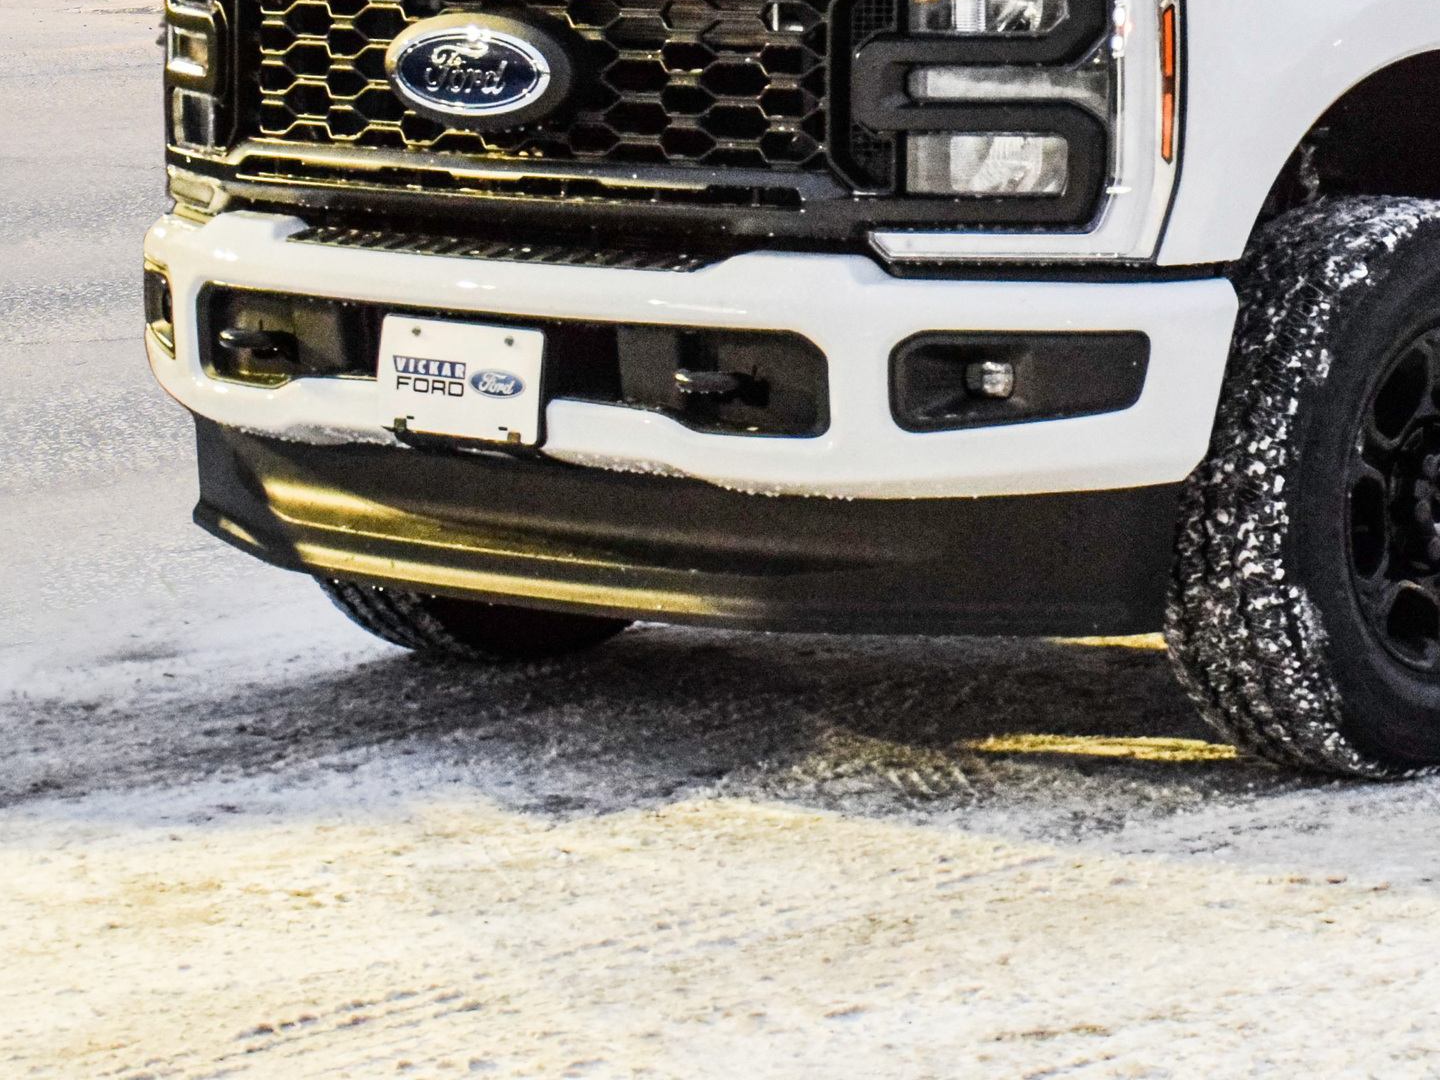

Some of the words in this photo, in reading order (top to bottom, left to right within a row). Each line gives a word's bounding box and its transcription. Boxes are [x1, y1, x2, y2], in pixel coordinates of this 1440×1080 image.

[425, 41, 508, 95] Ford
[395, 356, 466, 380] VICKAR
[396, 375, 465, 398] FORD
[478, 372, 515, 395] Ford
